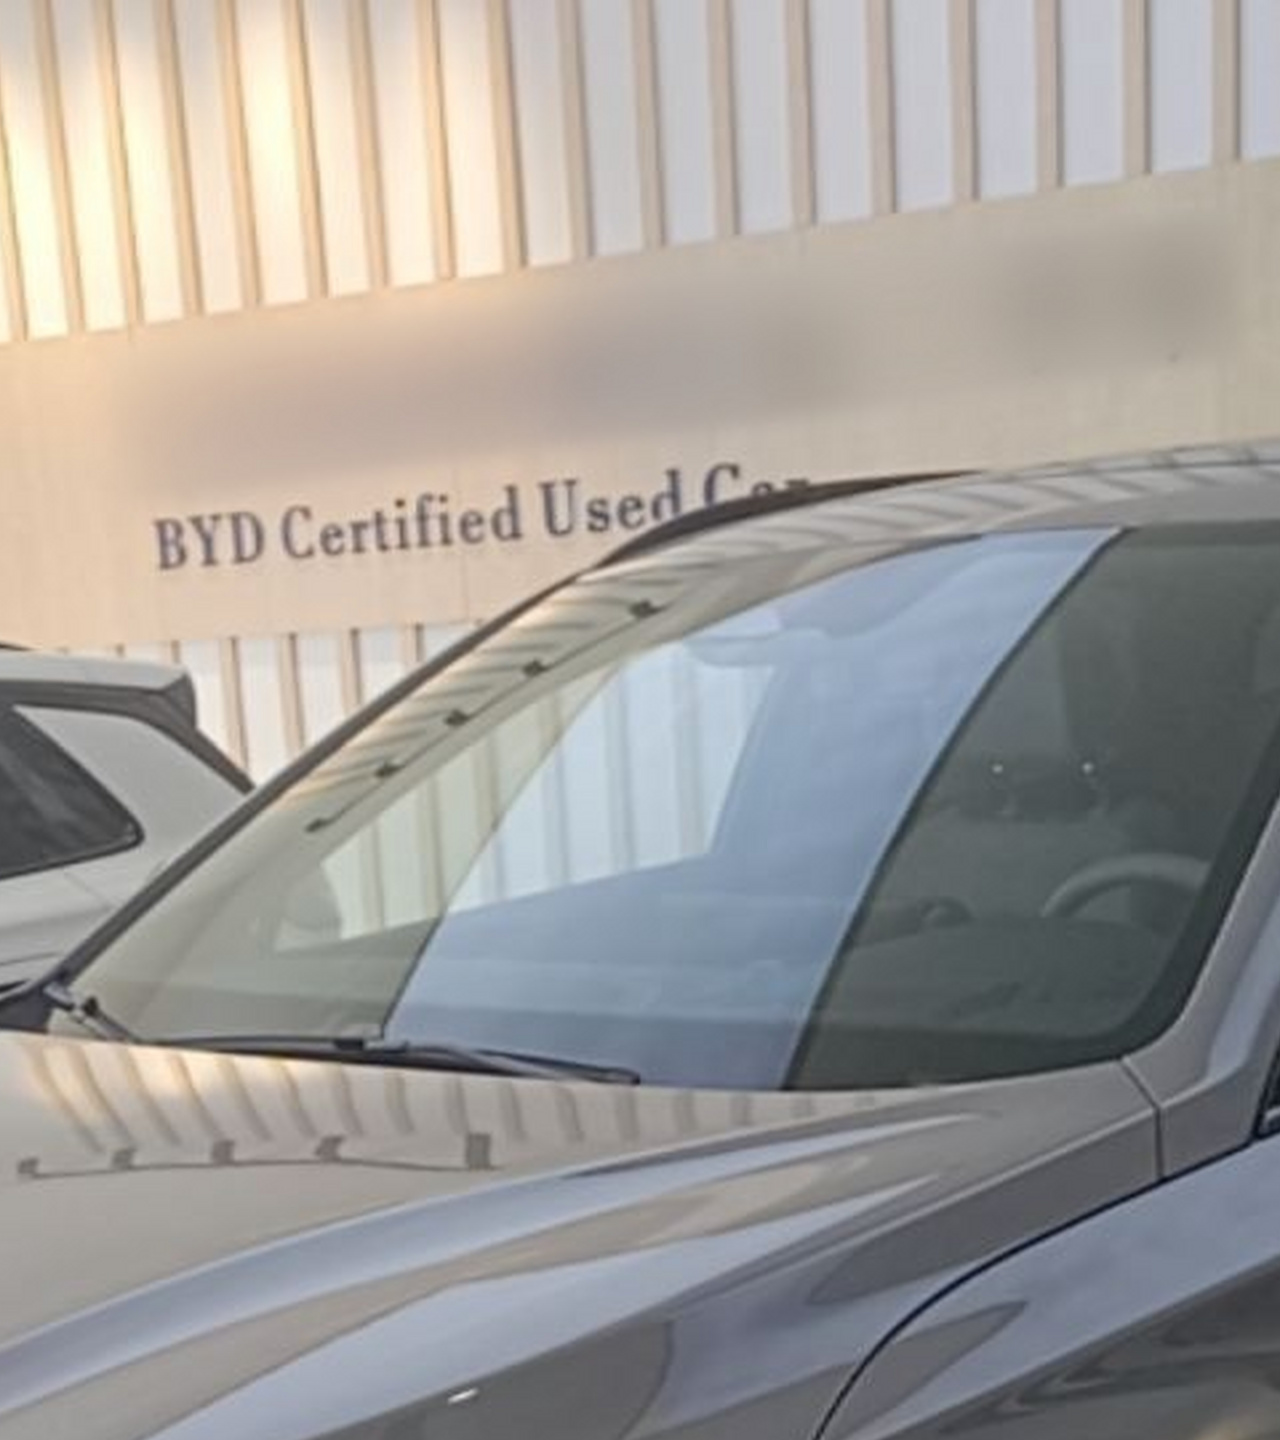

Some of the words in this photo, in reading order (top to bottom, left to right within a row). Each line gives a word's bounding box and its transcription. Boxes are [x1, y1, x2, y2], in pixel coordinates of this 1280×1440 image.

[153, 511, 265, 570] BYD
[281, 484, 524, 560] Certified
[538, 467, 681, 537] Used
